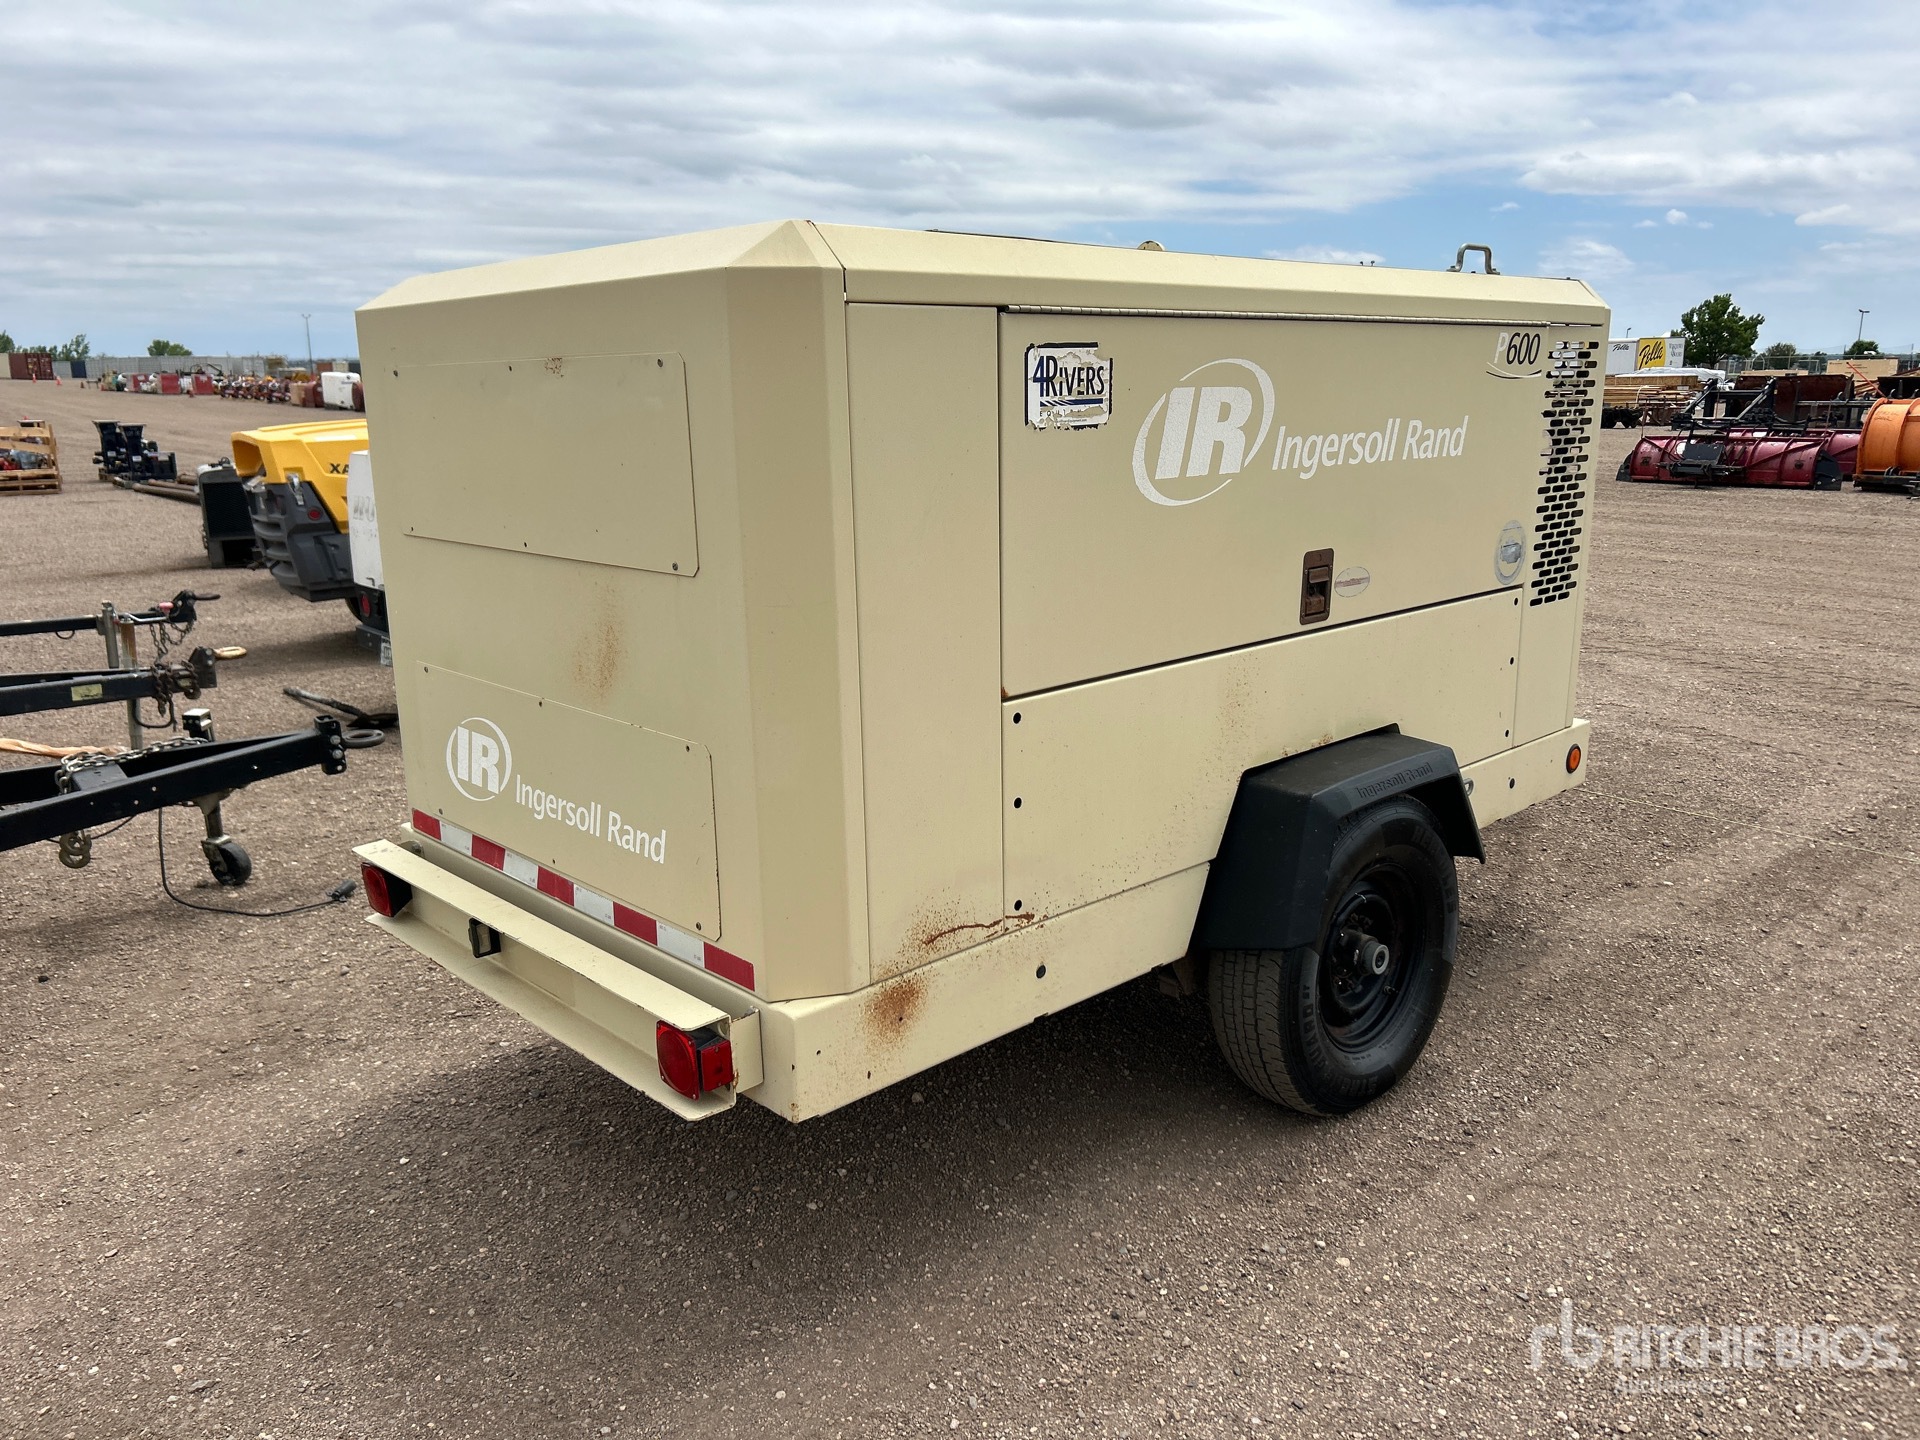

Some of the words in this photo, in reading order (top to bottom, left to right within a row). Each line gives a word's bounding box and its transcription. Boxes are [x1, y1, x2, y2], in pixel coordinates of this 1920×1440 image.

[1493, 332, 1541, 365] P600
[1639, 341, 1663, 370] Pella
[1154, 386, 1253, 480] IR
[1272, 418, 1401, 480] Ingersoll
[1402, 415, 1469, 460] Rand
[456, 725, 499, 795] IR
[1355, 772, 1407, 798] Ingersoll
[1404, 762, 1434, 782] Rand
[515, 774, 602, 838] Ingersoll
[607, 810, 667, 865] Rand
